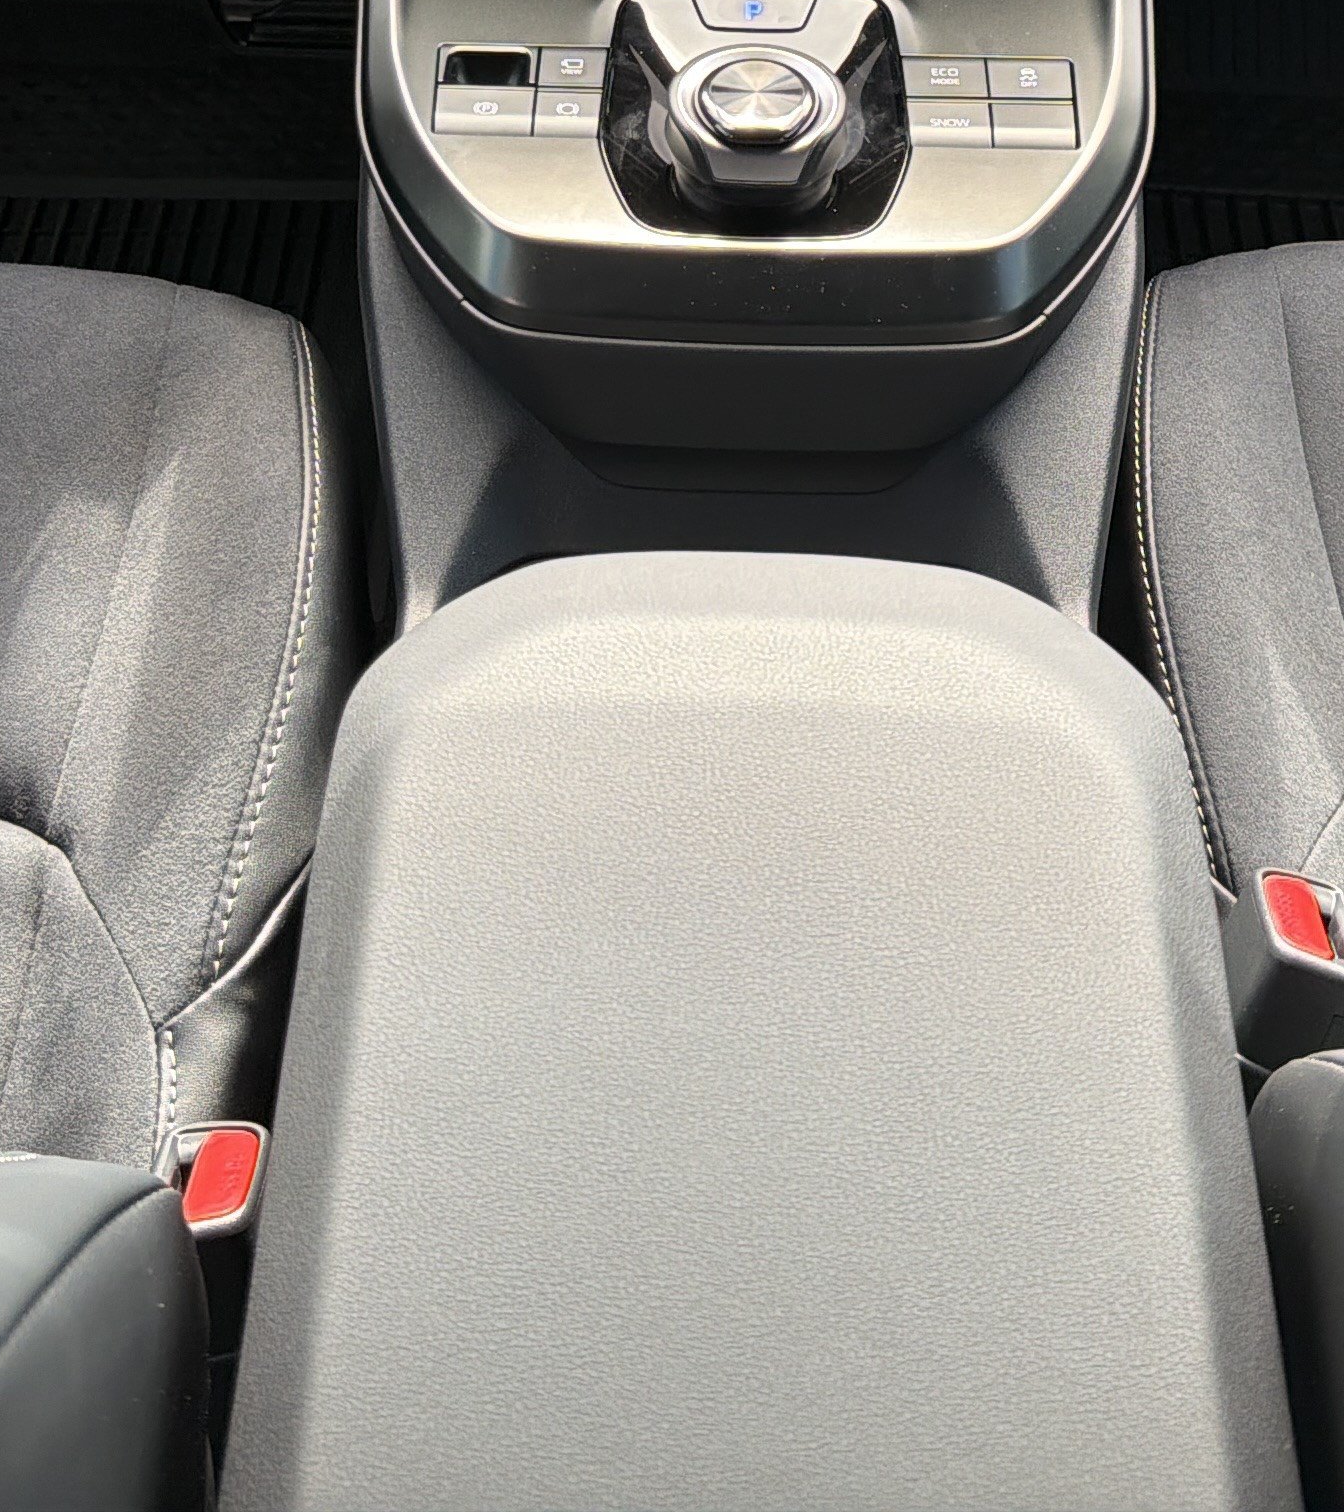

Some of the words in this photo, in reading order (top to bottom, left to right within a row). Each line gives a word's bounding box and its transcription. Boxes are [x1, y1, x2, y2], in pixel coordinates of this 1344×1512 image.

[744, 0, 763, 21] P
[930, 67, 959, 77] ECO
[930, 77, 960, 86] MODE
[1020, 80, 1038, 88] OFF
[930, 117, 971, 127] SNOW
